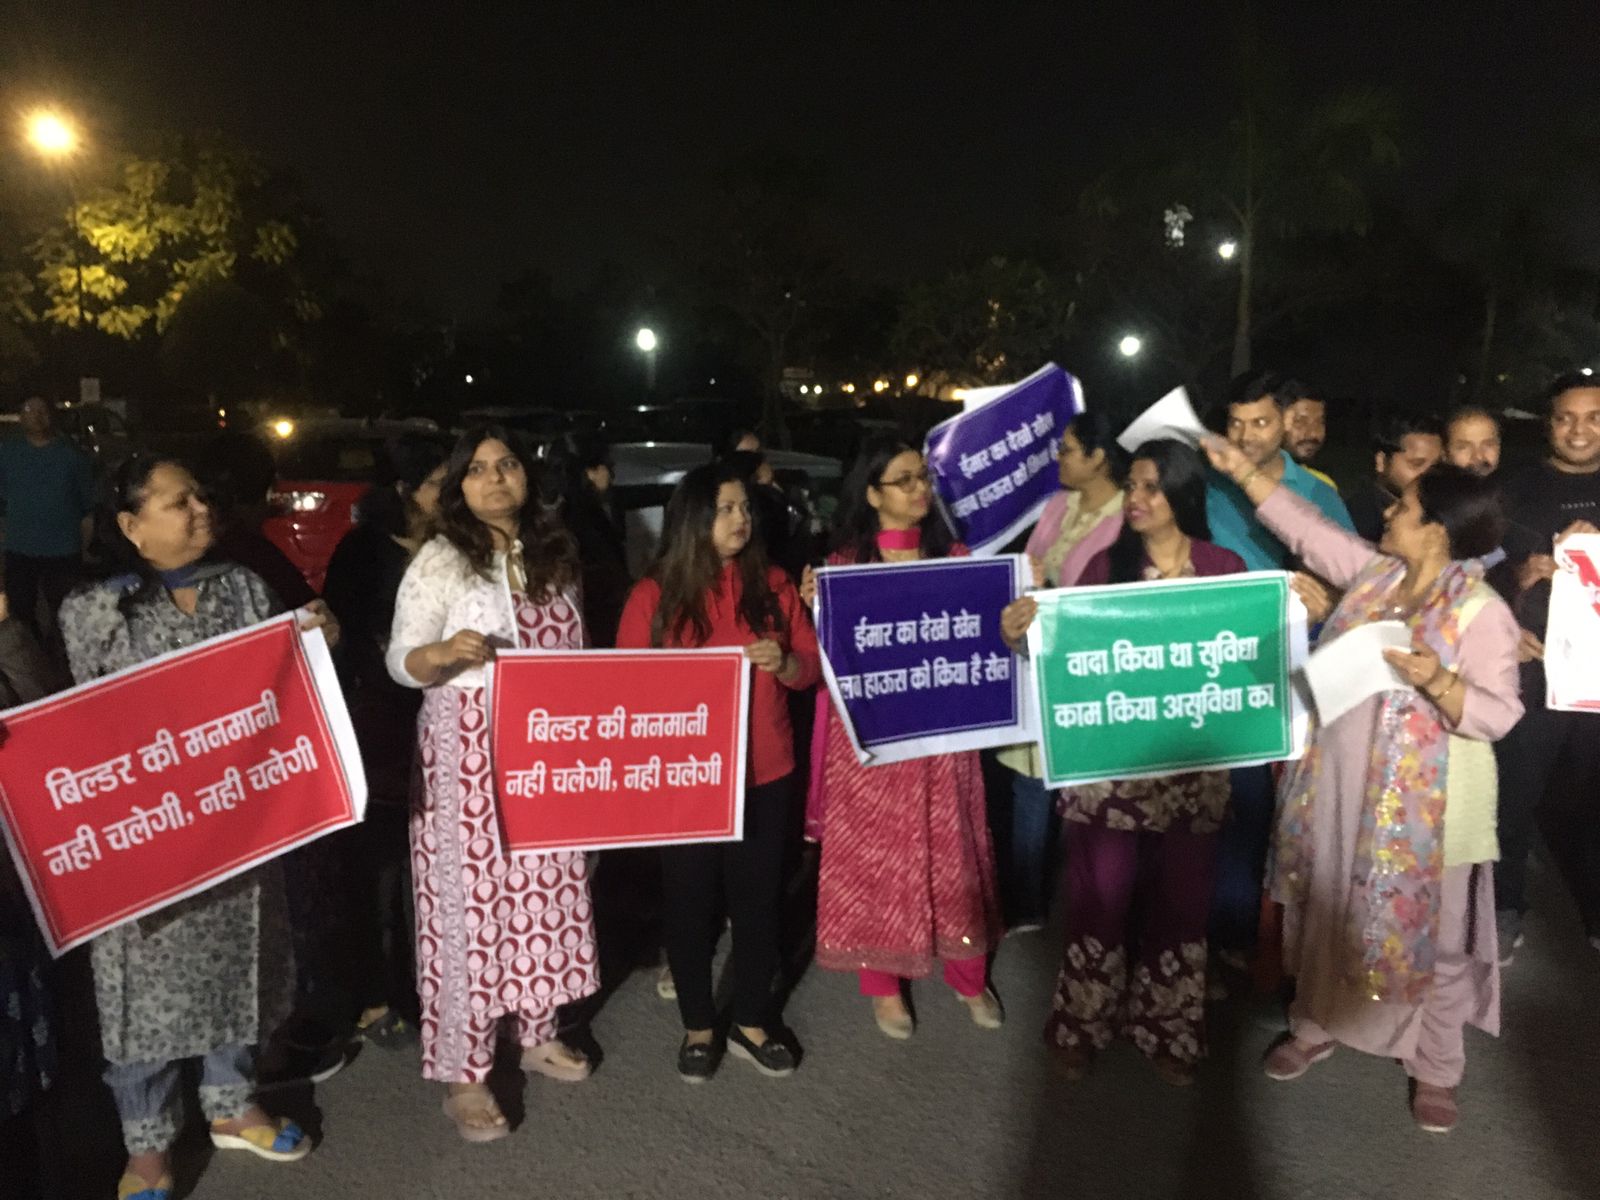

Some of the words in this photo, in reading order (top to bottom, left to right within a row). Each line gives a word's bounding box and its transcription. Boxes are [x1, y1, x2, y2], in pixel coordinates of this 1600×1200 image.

[853, 616, 894, 653] ईमार
[895, 621, 918, 644] का
[919, 611, 950, 643] देखो
[1065, 649, 1109, 677] वादा
[1111, 639, 1165, 674] किया
[1168, 642, 1193, 668] था
[1196, 630, 1260, 679] सुविधा
[863, 669, 908, 699] हाऊस
[909, 660, 931, 690] को
[932, 657, 969, 688] किया
[969, 653, 983, 686] है
[526, 707, 593, 744] बिल्डर
[596, 705, 627, 740] की
[630, 702, 709, 738] मनमानी
[1052, 700, 1103, 729] काम
[1105, 690, 1158, 724] किया
[1162, 681, 1244, 729] असुविधा
[1246, 683, 1276, 710] का
[44, 754, 137, 811] बिल्डर
[136, 728, 181, 774] की
[178, 688, 281, 758] मनमानी
[505, 760, 547, 799] नही
[623, 755, 662, 792] नही
[665, 751, 723, 787] चलेगी
[42, 823, 102, 876] नही
[194, 766, 246, 815] नही
[246, 734, 319, 791] चलेगी
